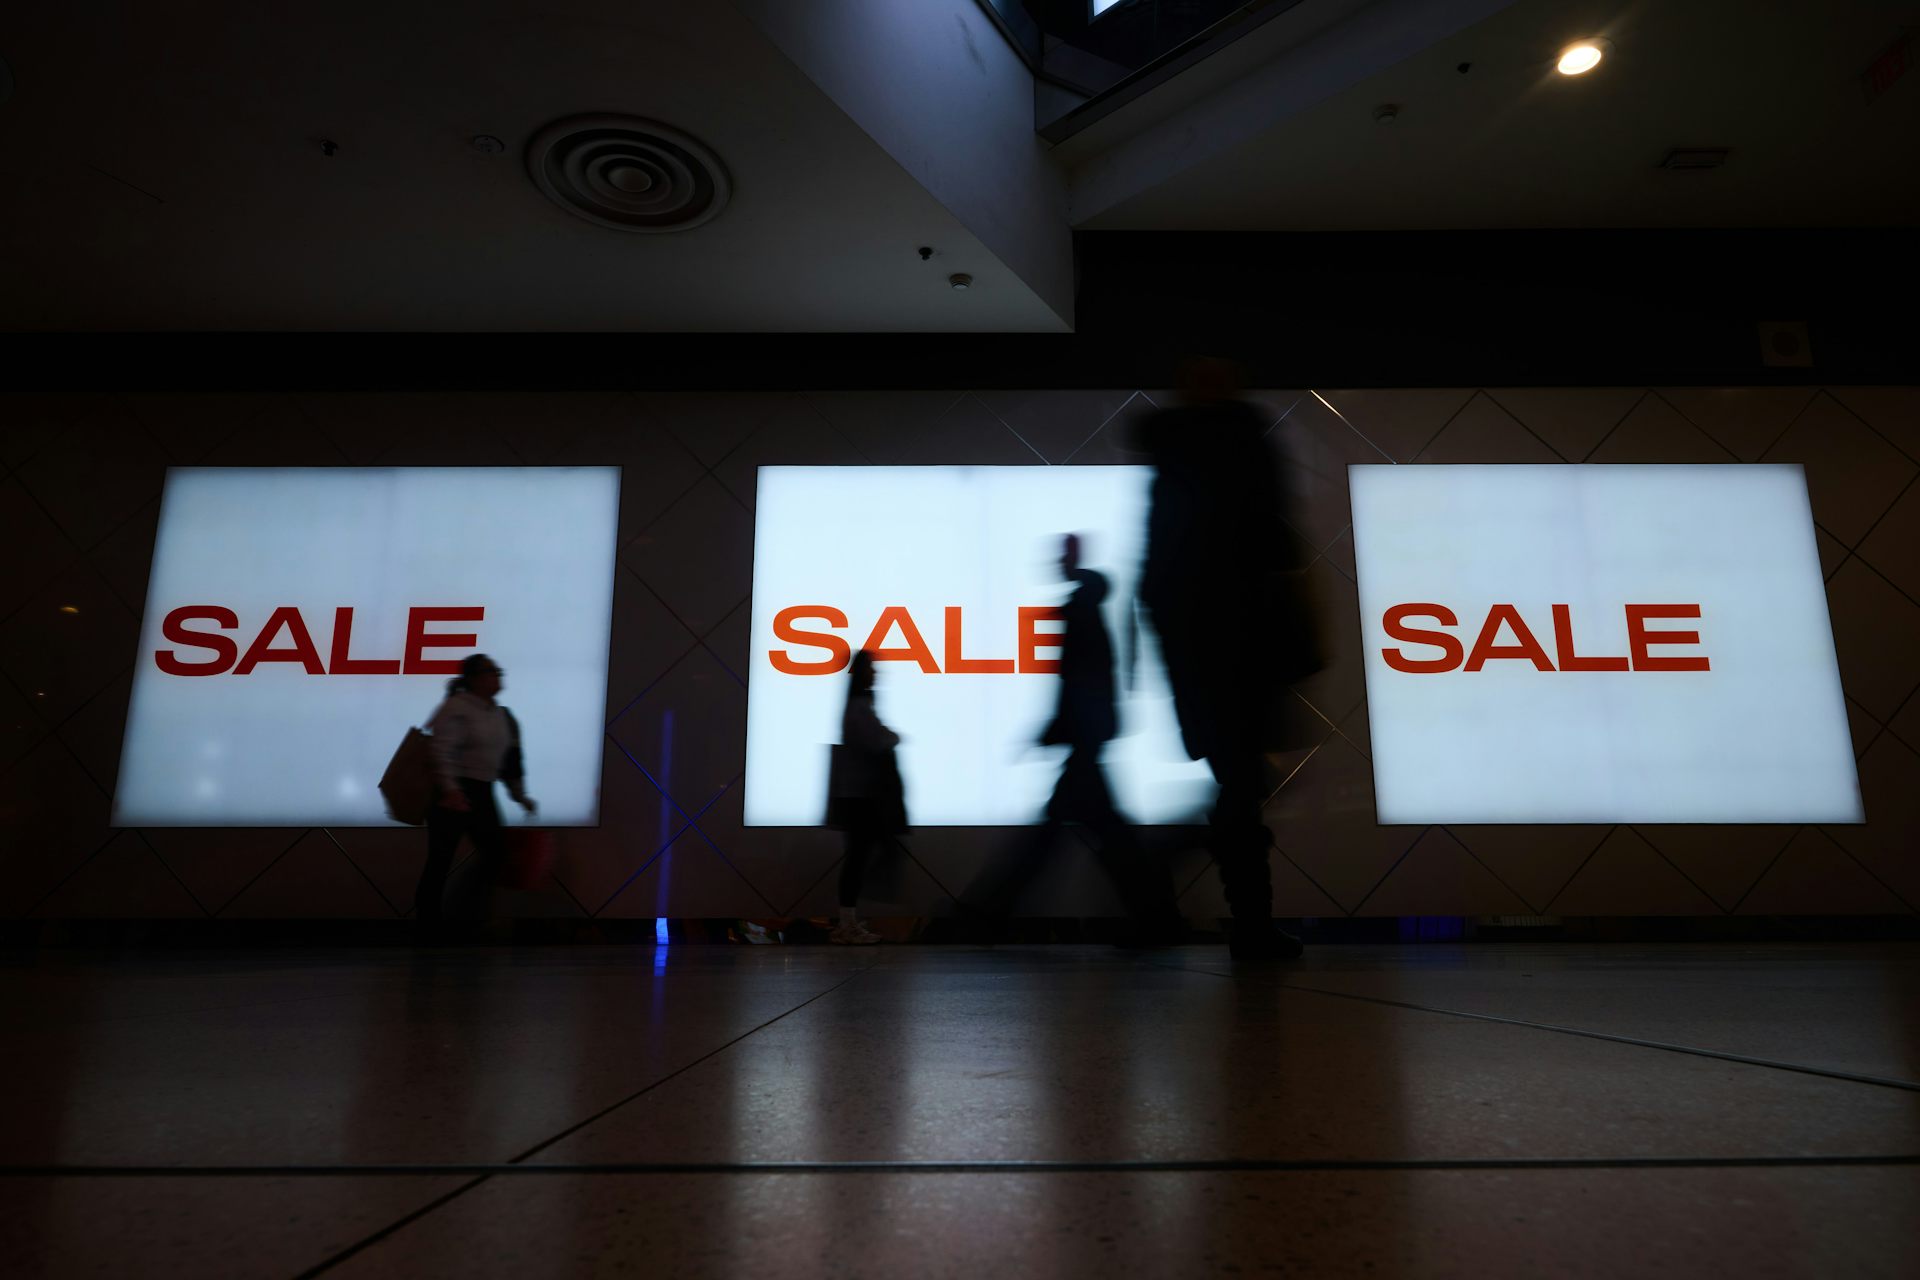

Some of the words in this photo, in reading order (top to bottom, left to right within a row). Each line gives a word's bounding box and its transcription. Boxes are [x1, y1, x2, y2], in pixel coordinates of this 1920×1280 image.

[155, 605, 485, 676] SALE
[768, 605, 1064, 675] SALE
[1381, 603, 1711, 673] SALE
